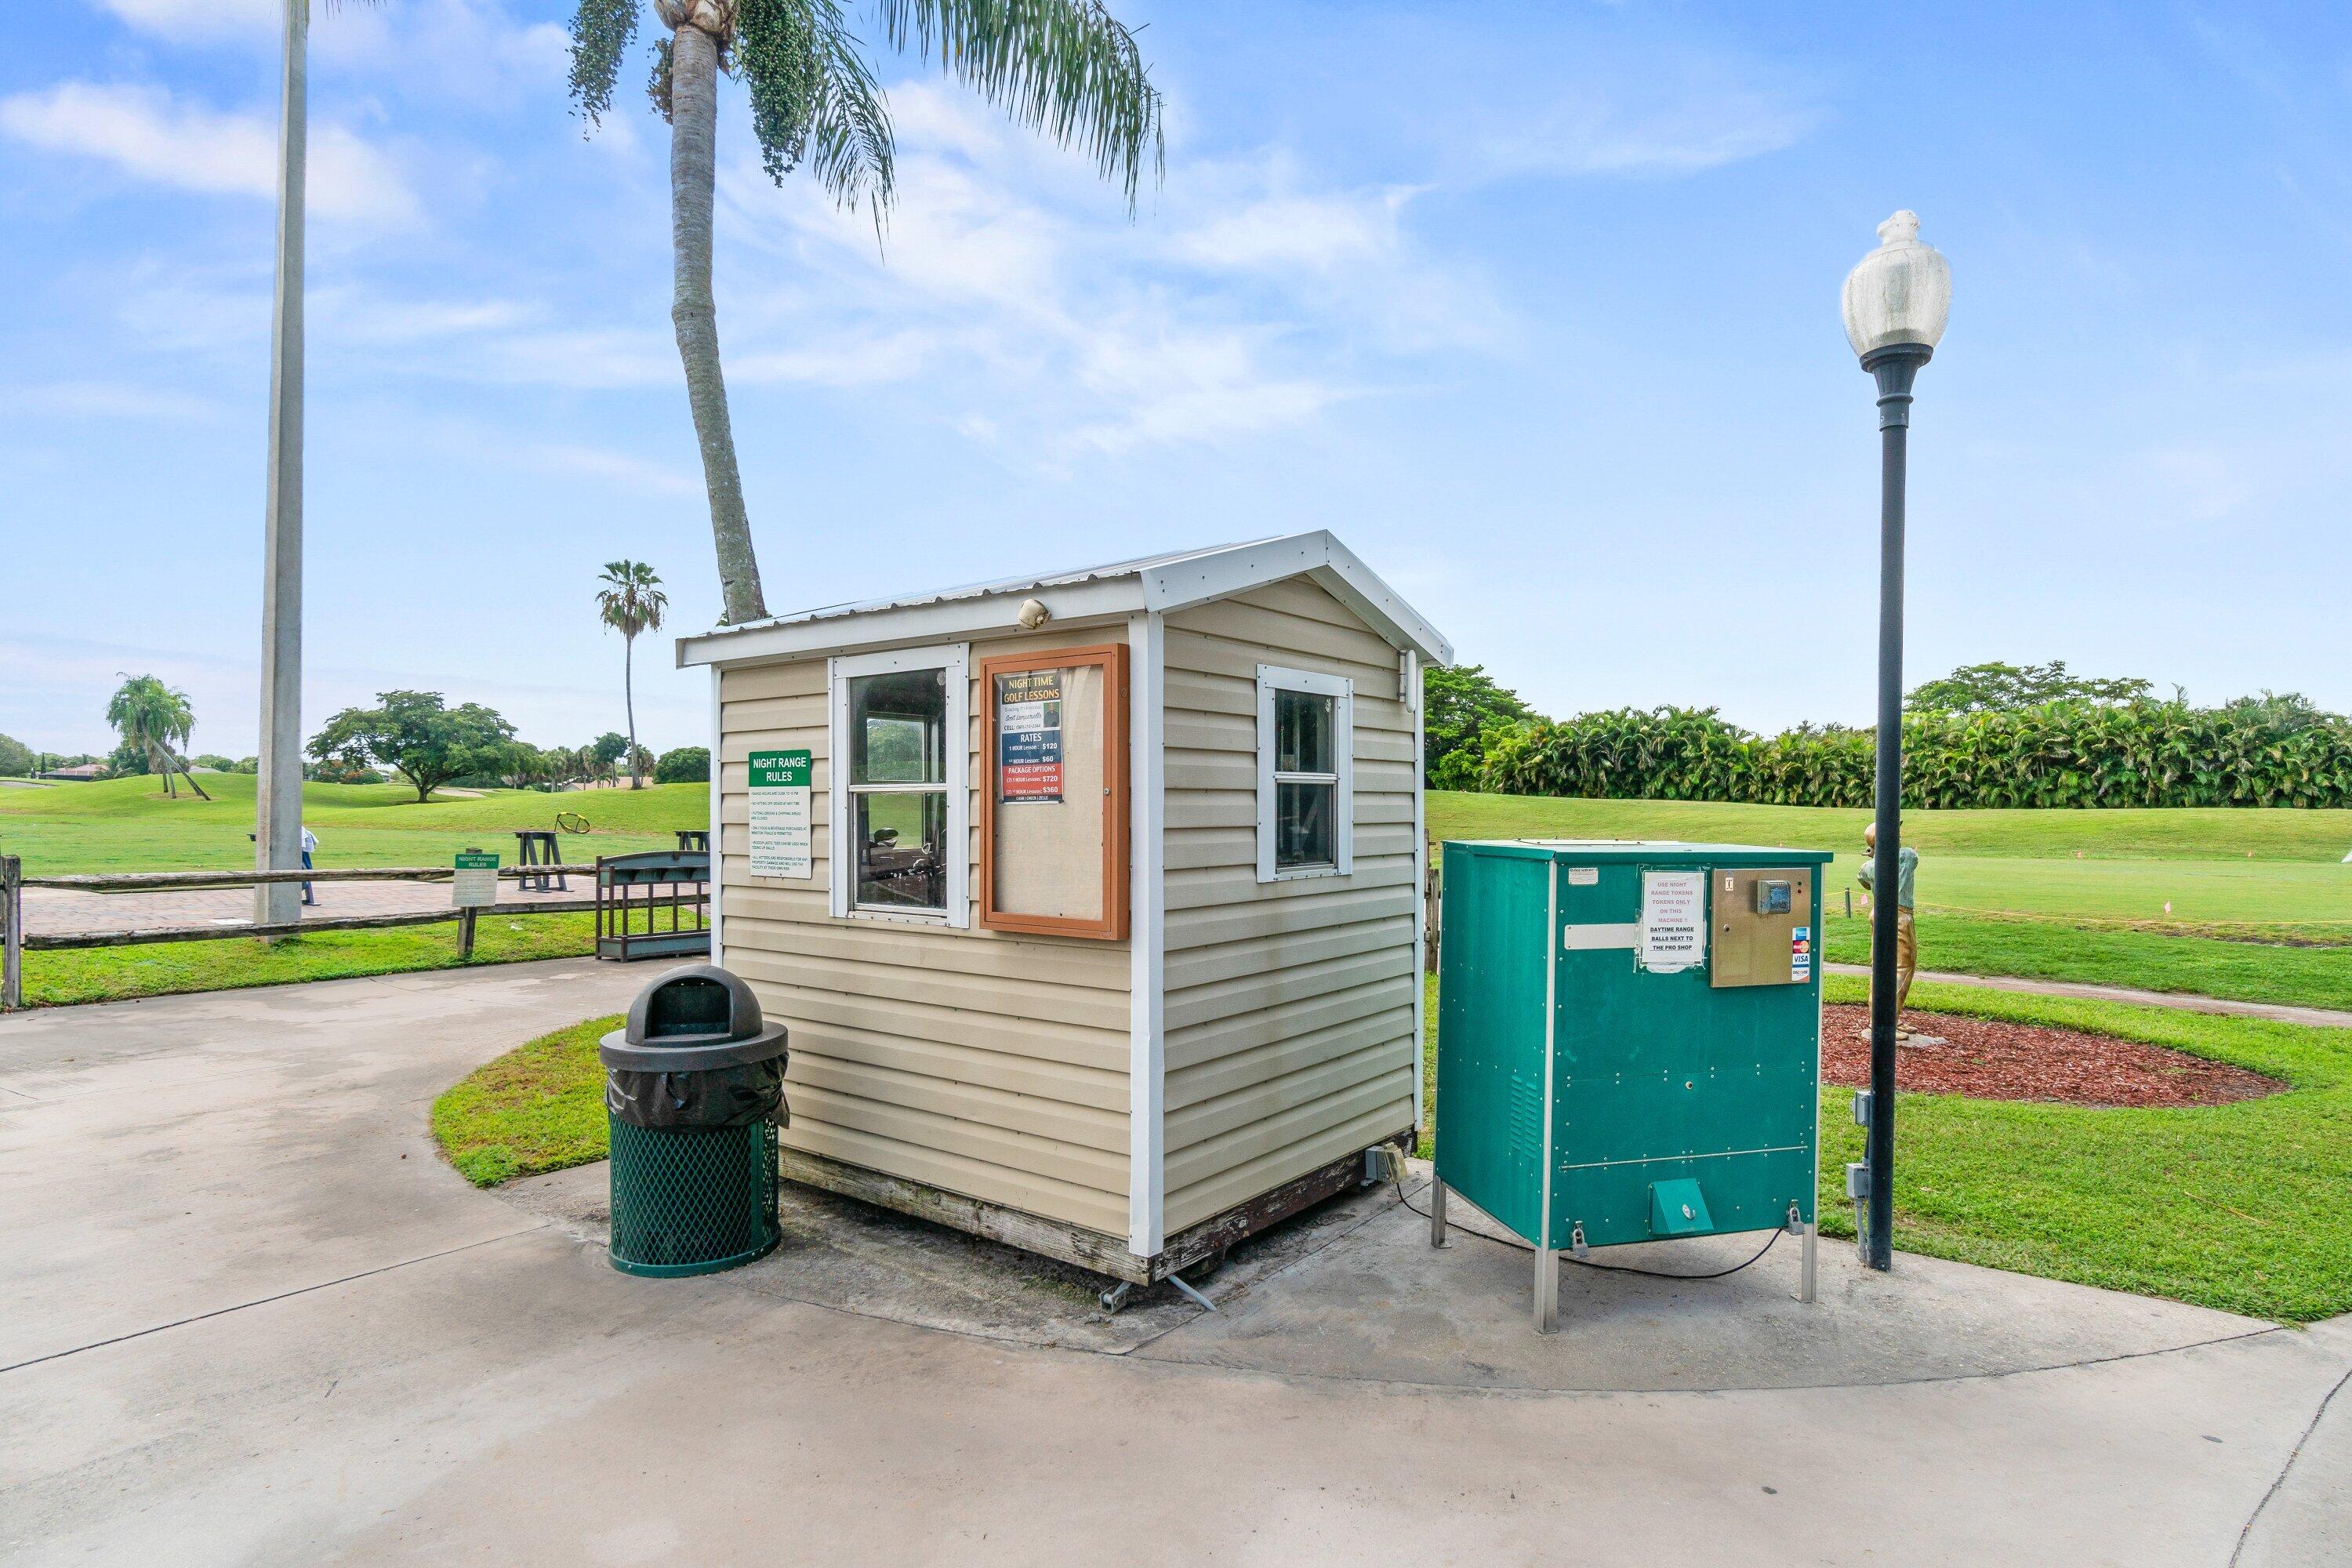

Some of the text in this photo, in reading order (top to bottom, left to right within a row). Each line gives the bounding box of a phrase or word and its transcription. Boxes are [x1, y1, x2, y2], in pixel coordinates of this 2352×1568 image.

[1009, 676, 1054, 689] NIGHT TIME
[1004, 689, 1059, 702] GOLF LESSONS
[1021, 733, 1041, 742] RATES
[753, 757, 806, 768] NIGHT RANGE
[767, 771, 792, 782] RULES
